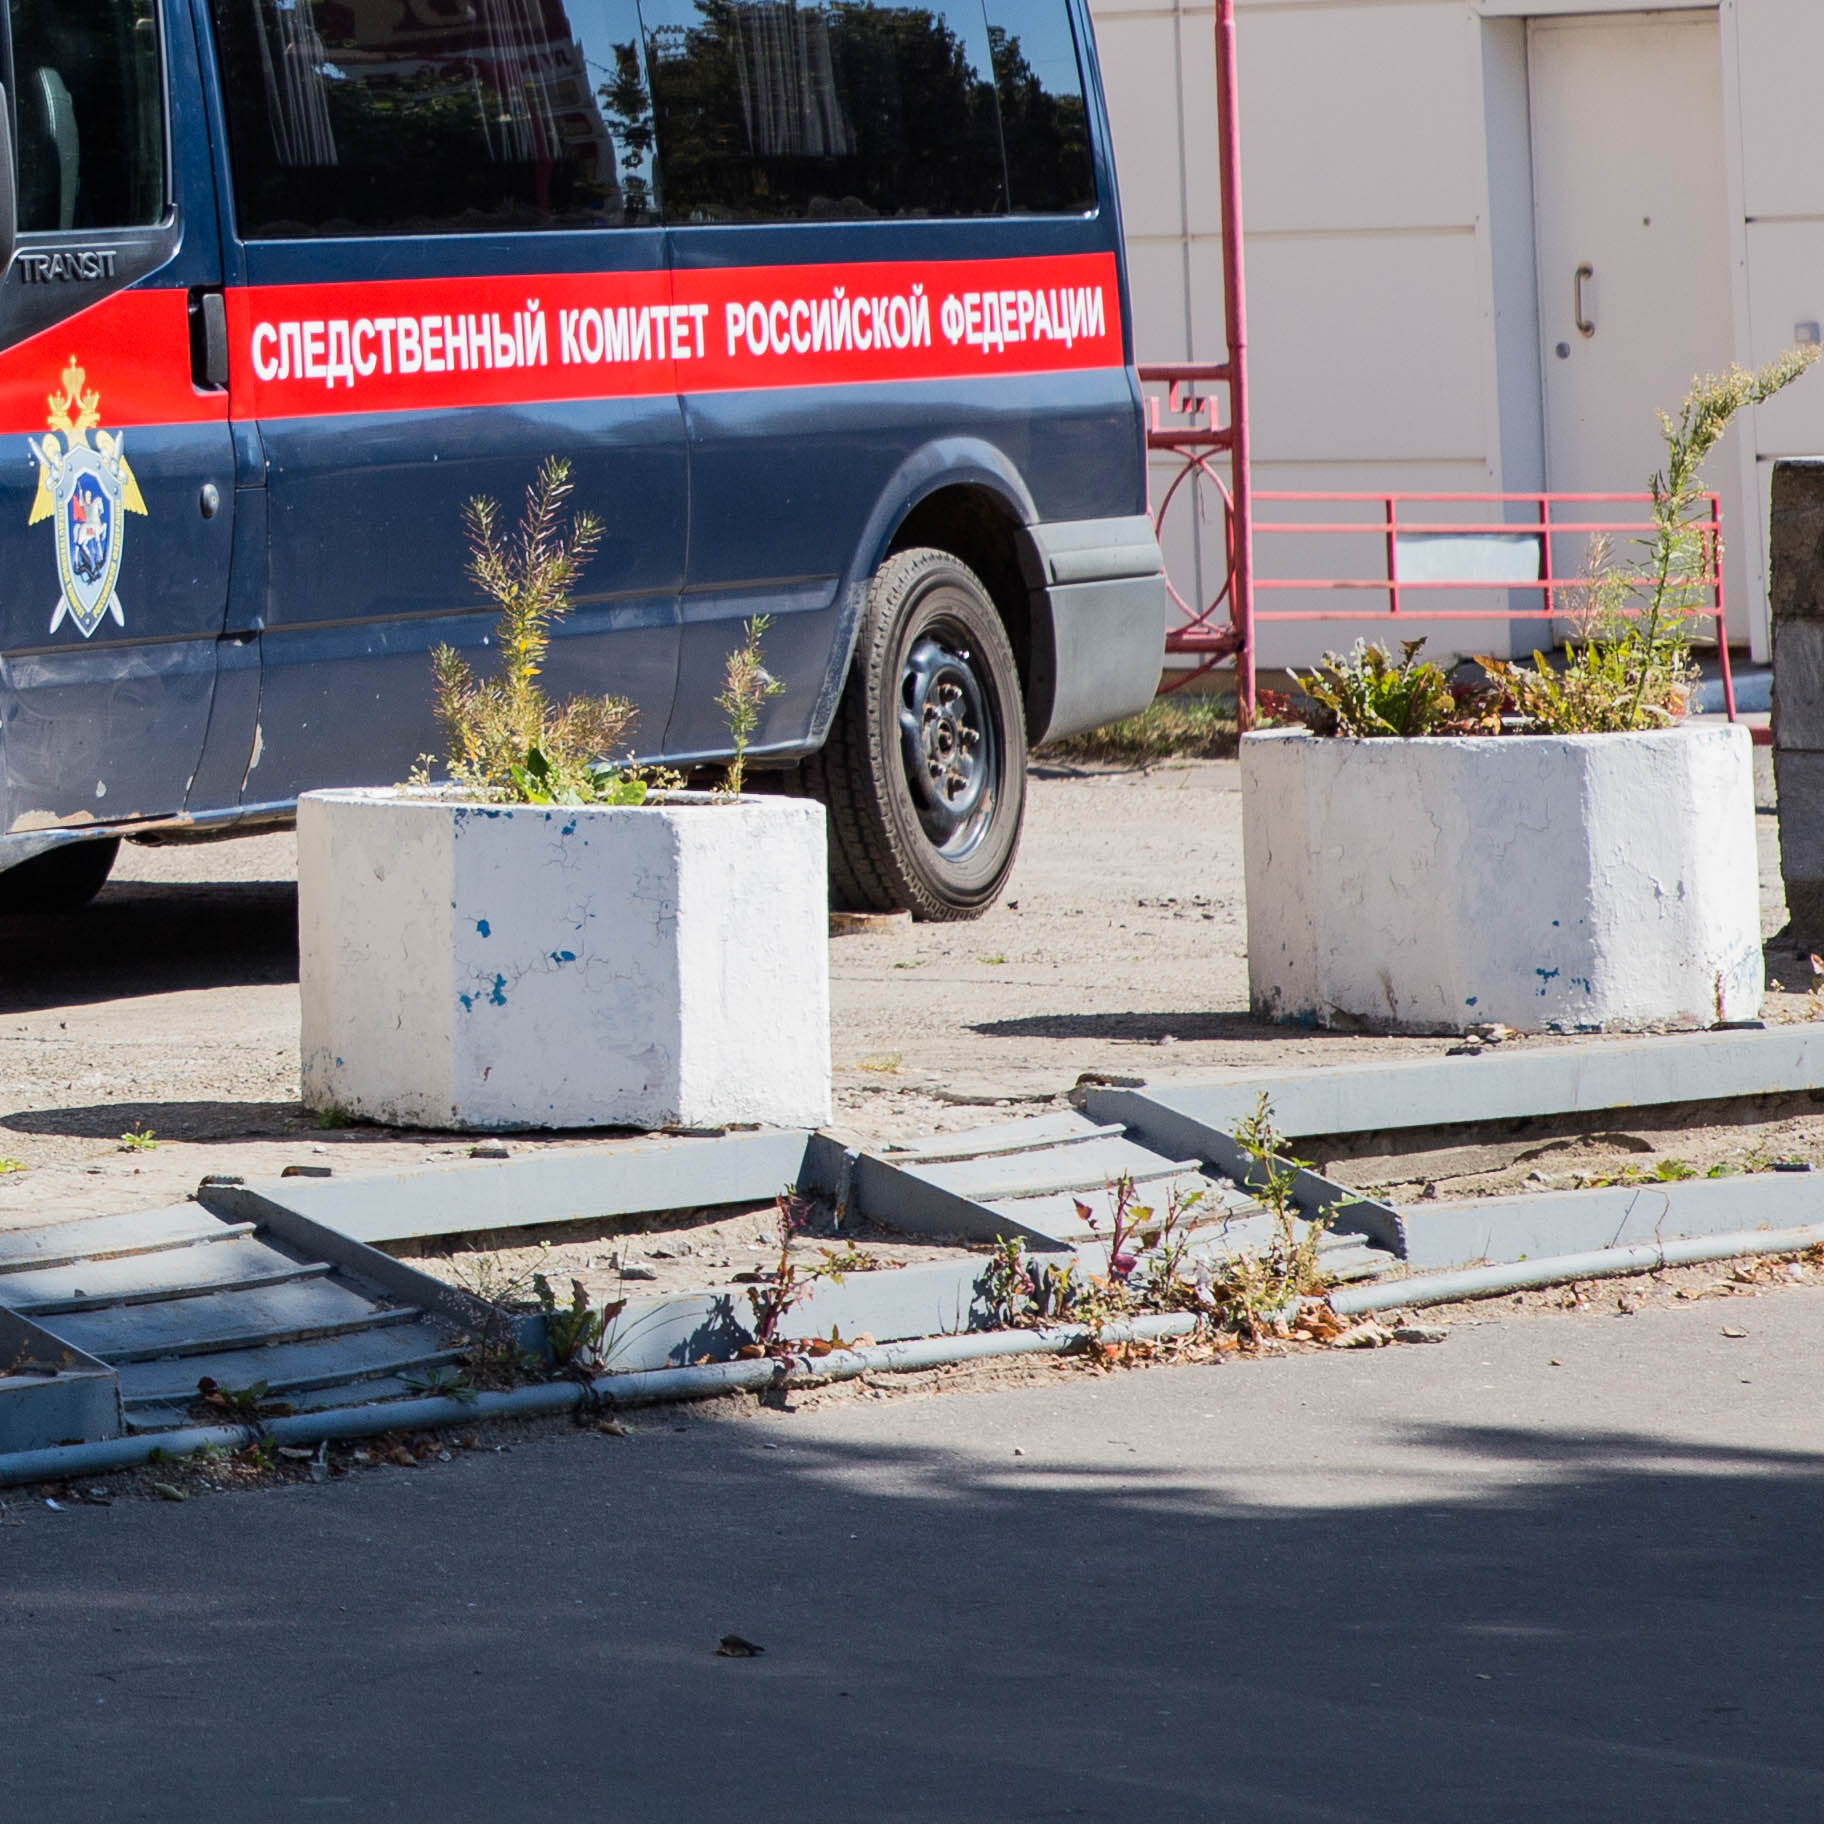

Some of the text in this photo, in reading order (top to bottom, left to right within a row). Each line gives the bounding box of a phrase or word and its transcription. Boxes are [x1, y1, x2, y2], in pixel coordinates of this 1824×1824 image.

[17, 250, 118, 283] TRANSIT
[250, 283, 1106, 389] СЛЕДСТВЕННЫЙ КОМИТЕТ РОССИЙСКОЙ ФЕДЕРАЦИИ
